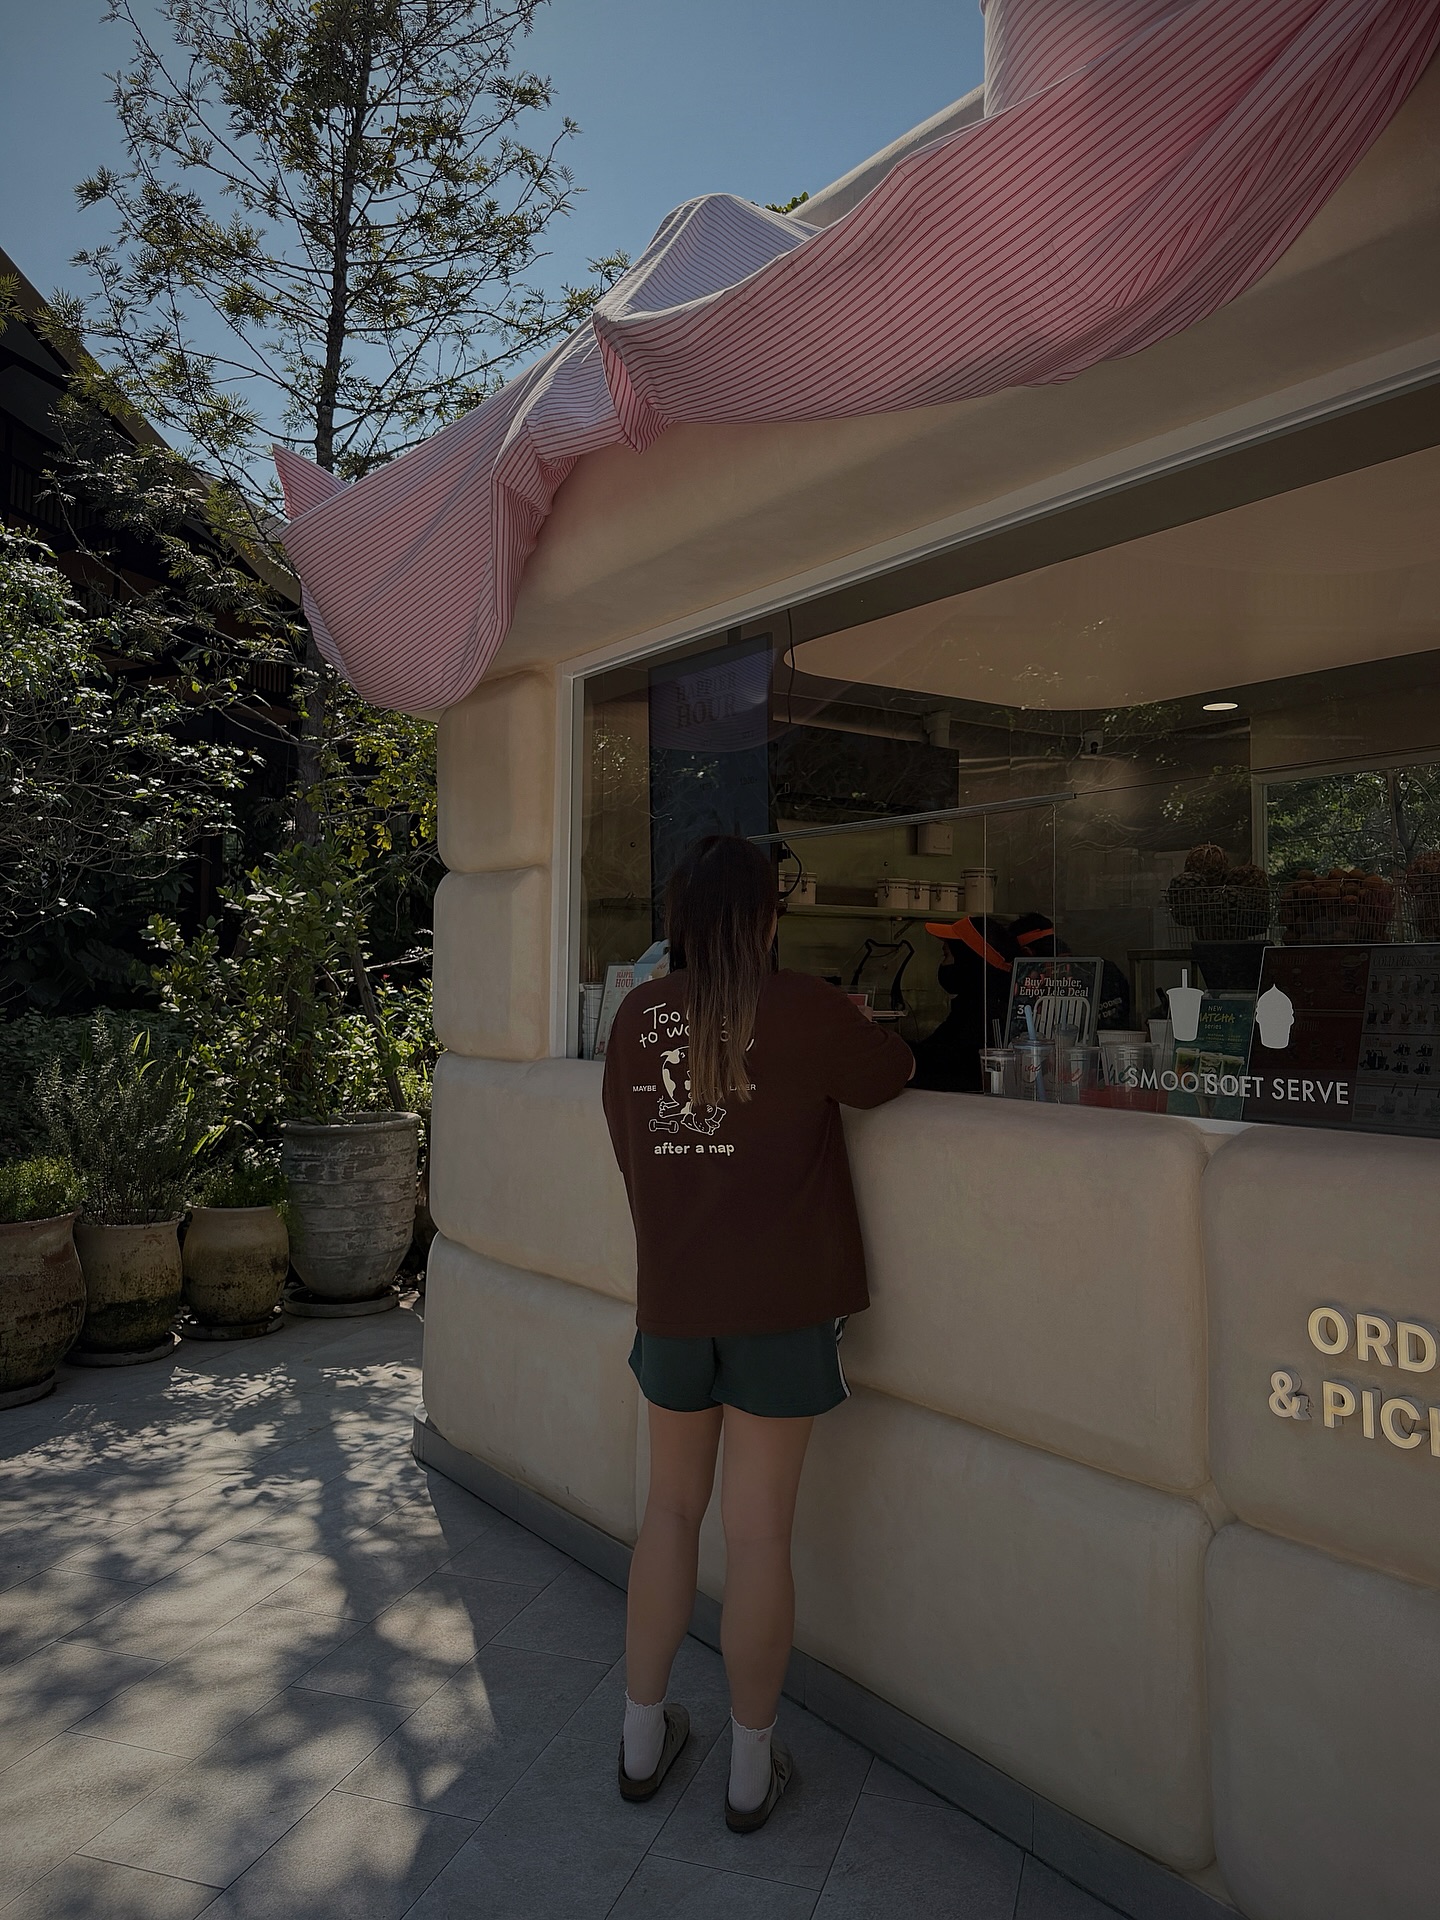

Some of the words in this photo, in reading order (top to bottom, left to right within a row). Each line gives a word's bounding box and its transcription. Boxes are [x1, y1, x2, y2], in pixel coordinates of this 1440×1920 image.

[675, 695, 737, 729] HOUR
[1024, 977, 1042, 989] Buy
[1044, 976, 1082, 989] Tumbler,
[1019, 986, 1045, 998] Enjoy
[1067, 986, 1089, 997] Deal
[643, 1002, 681, 1030] Too
[639, 1031, 659, 1049] to
[632, 1083, 657, 1092] MAYBE
[1271, 1077, 1350, 1106] SERVE
[653, 1141, 691, 1155] after
[695, 1144, 705, 1154] a
[708, 1142, 735, 1157] nap
[1268, 1369, 1303, 1420] &
